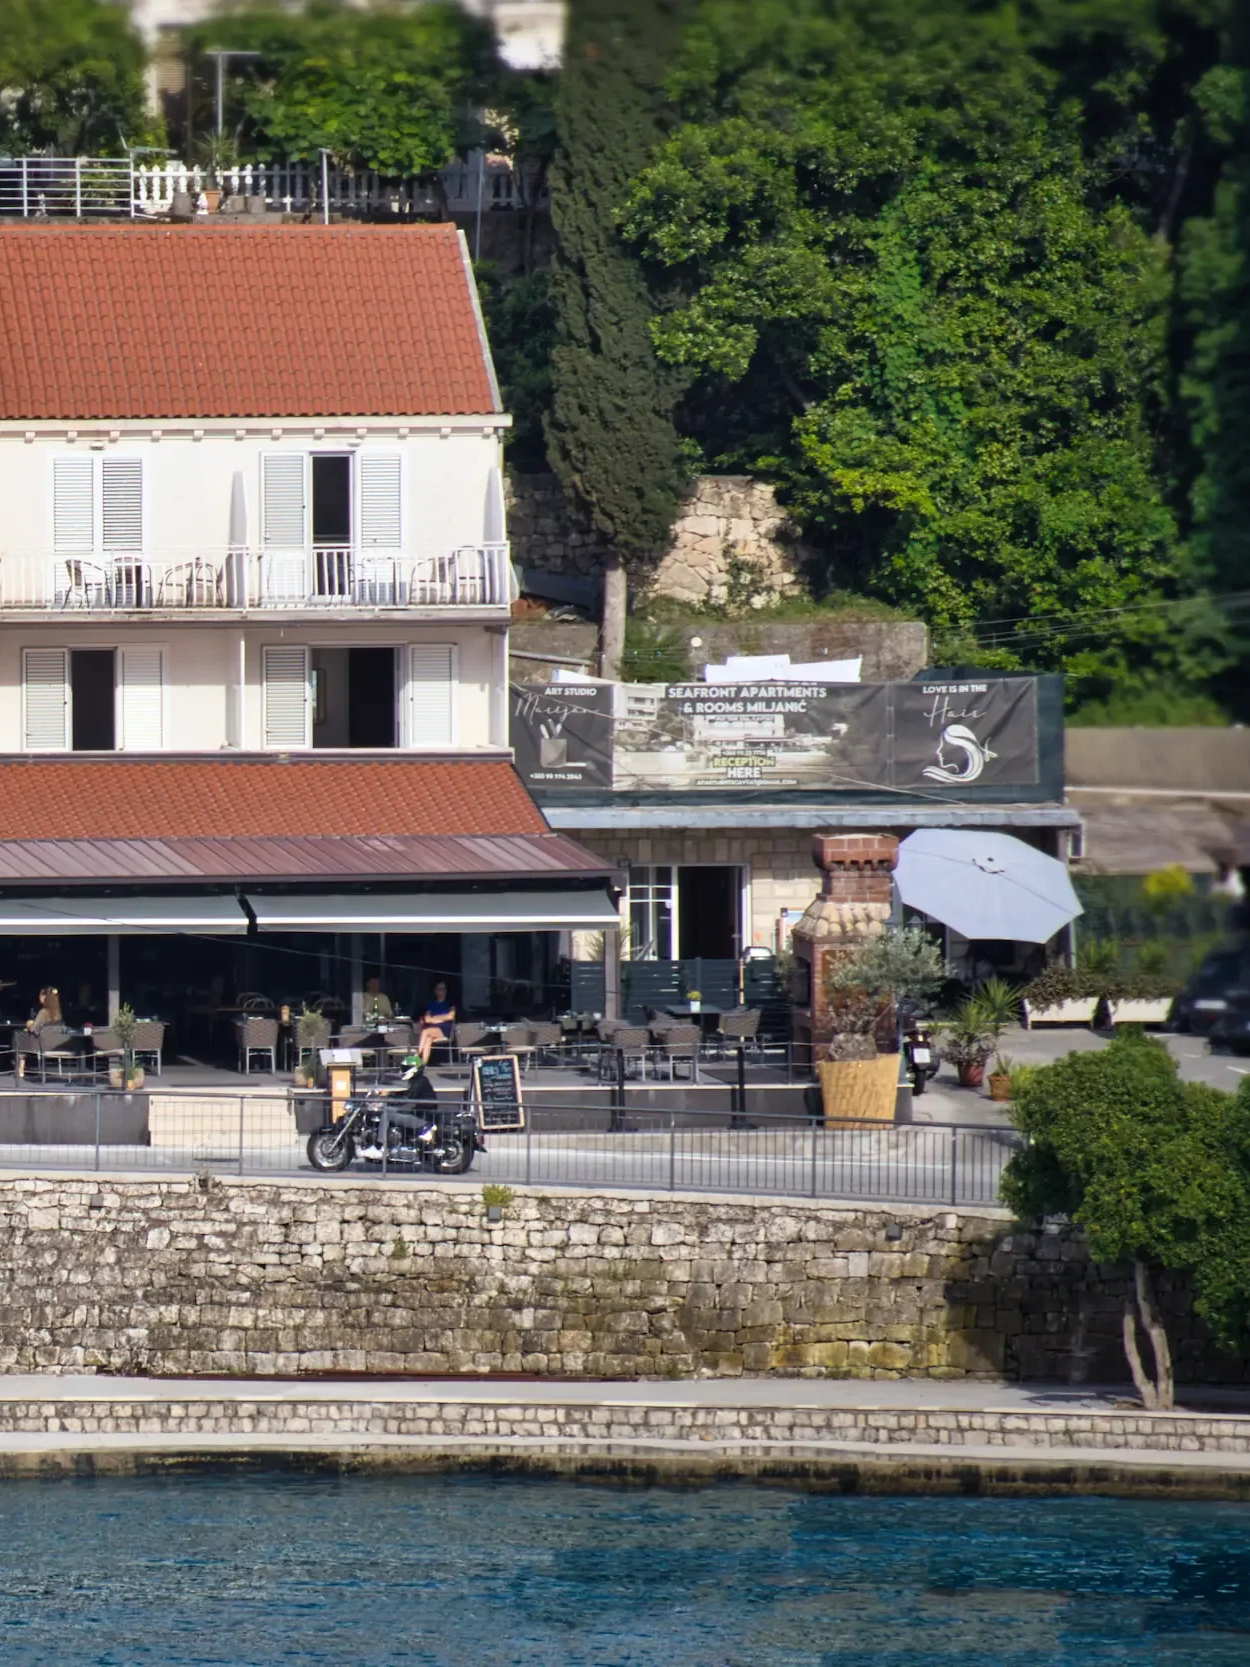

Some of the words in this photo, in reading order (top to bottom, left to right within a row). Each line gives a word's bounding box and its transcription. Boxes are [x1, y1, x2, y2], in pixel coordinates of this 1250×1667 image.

[544, 687, 562, 696] ART
[563, 687, 598, 696] STUDIO
[668, 687, 737, 698] SEAFRONT
[739, 687, 827, 698] APARTMENTS
[922, 686, 947, 694] LOVE
[949, 685, 958, 693] IS
[970, 684, 988, 692] THE
[683, 702, 694, 713] &
[695, 702, 745, 713] ROOMS
[746, 699, 807, 713] MILJANIĆ
[922, 694, 987, 728] Hair
[713, 757, 775, 767] RECEPTION
[727, 767, 762, 778] HERE
